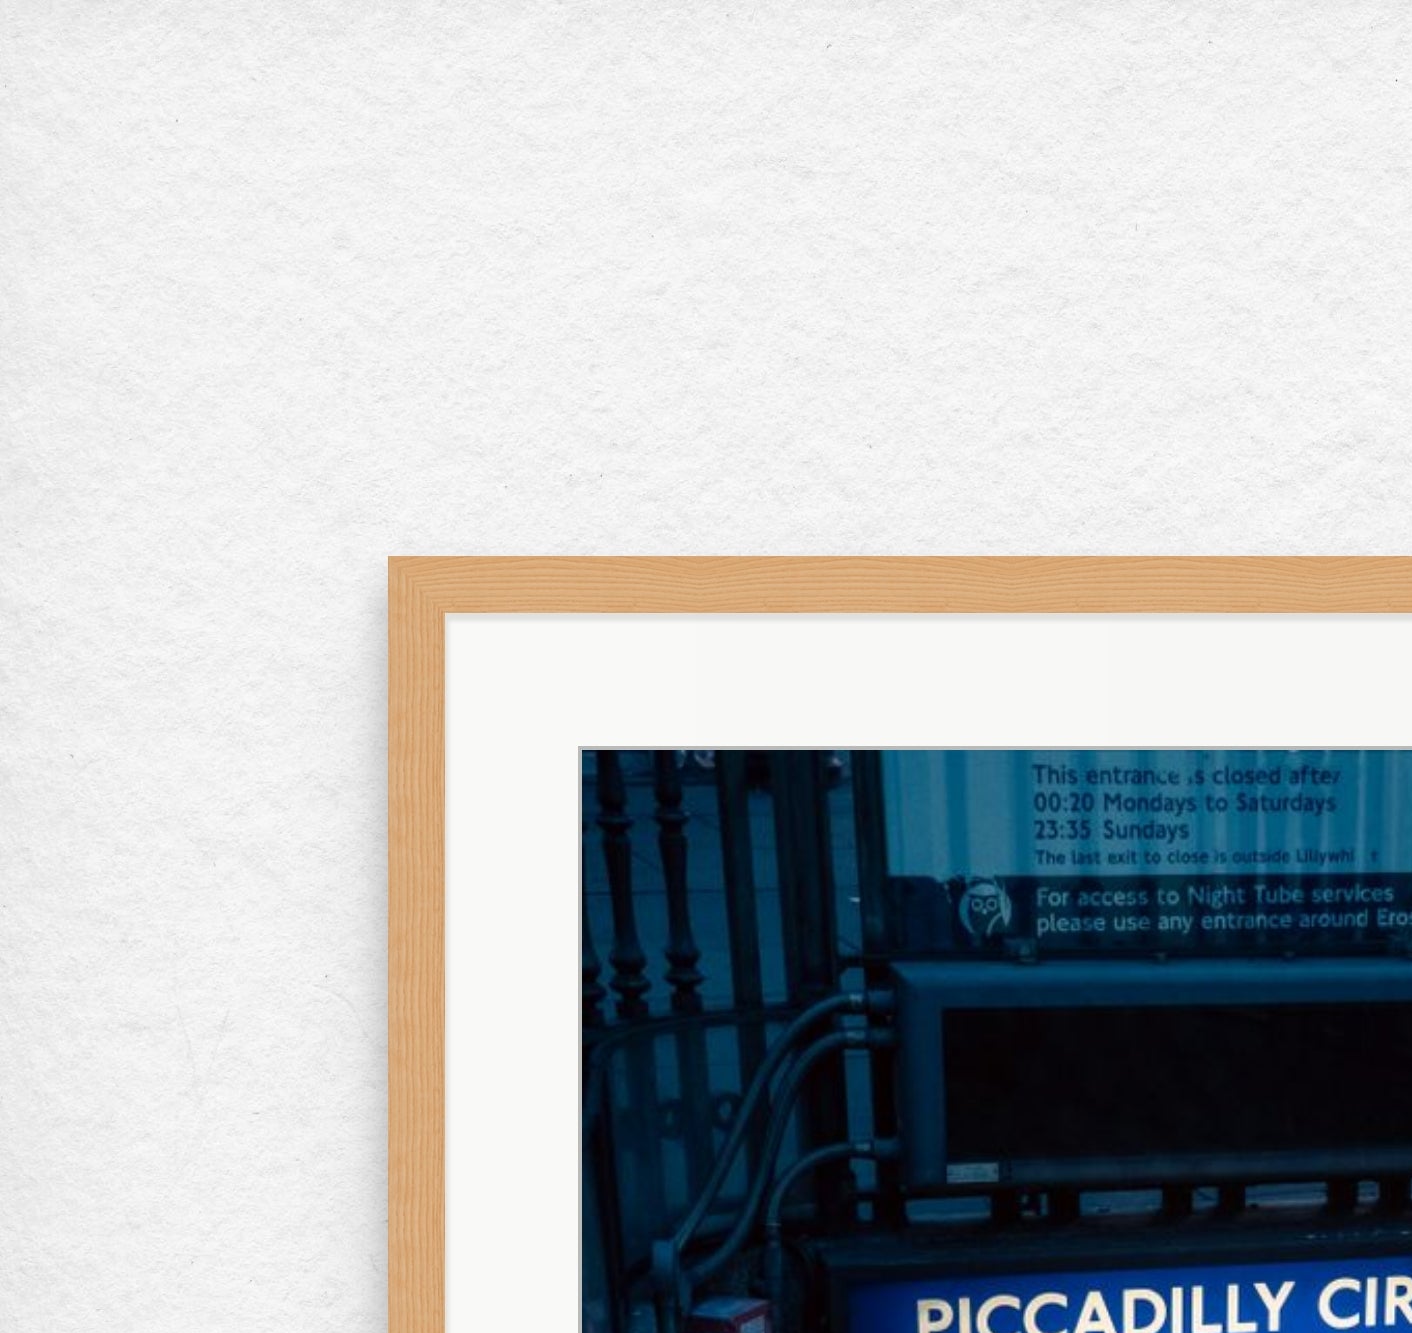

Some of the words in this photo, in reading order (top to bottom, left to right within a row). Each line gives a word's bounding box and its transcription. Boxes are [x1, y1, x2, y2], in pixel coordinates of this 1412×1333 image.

[1033, 764, 1078, 784] This
[1085, 766, 1180, 785] entrance
[1212, 766, 1281, 785] closed
[1288, 764, 1341, 785] after
[1033, 792, 1095, 813] 00:20
[1103, 792, 1197, 817] Mondays
[1205, 796, 1228, 813] to
[1235, 792, 1337, 816] Saturdays
[1034, 819, 1092, 840] 23:35
[1103, 819, 1190, 844] Sundays
[1037, 851, 1066, 865] The
[1071, 850, 1099, 864] last
[1108, 850, 1136, 864] exit
[1143, 850, 1161, 864] to
[1167, 849, 1209, 864] close
[1214, 850, 1227, 864] is
[1232, 849, 1290, 864] outside
[1036, 887, 1070, 907] For
[1077, 888, 1149, 906] access
[1157, 888, 1180, 905] to
[1187, 885, 1246, 909] Night
[1254, 884, 1304, 904] Tube
[1311, 884, 1394, 903] services
[1036, 913, 1106, 938] please
[1113, 914, 1149, 931] use
[1157, 914, 1193, 934] any
[1200, 910, 1292, 930] entrance
[1299, 908, 1368, 928] around
